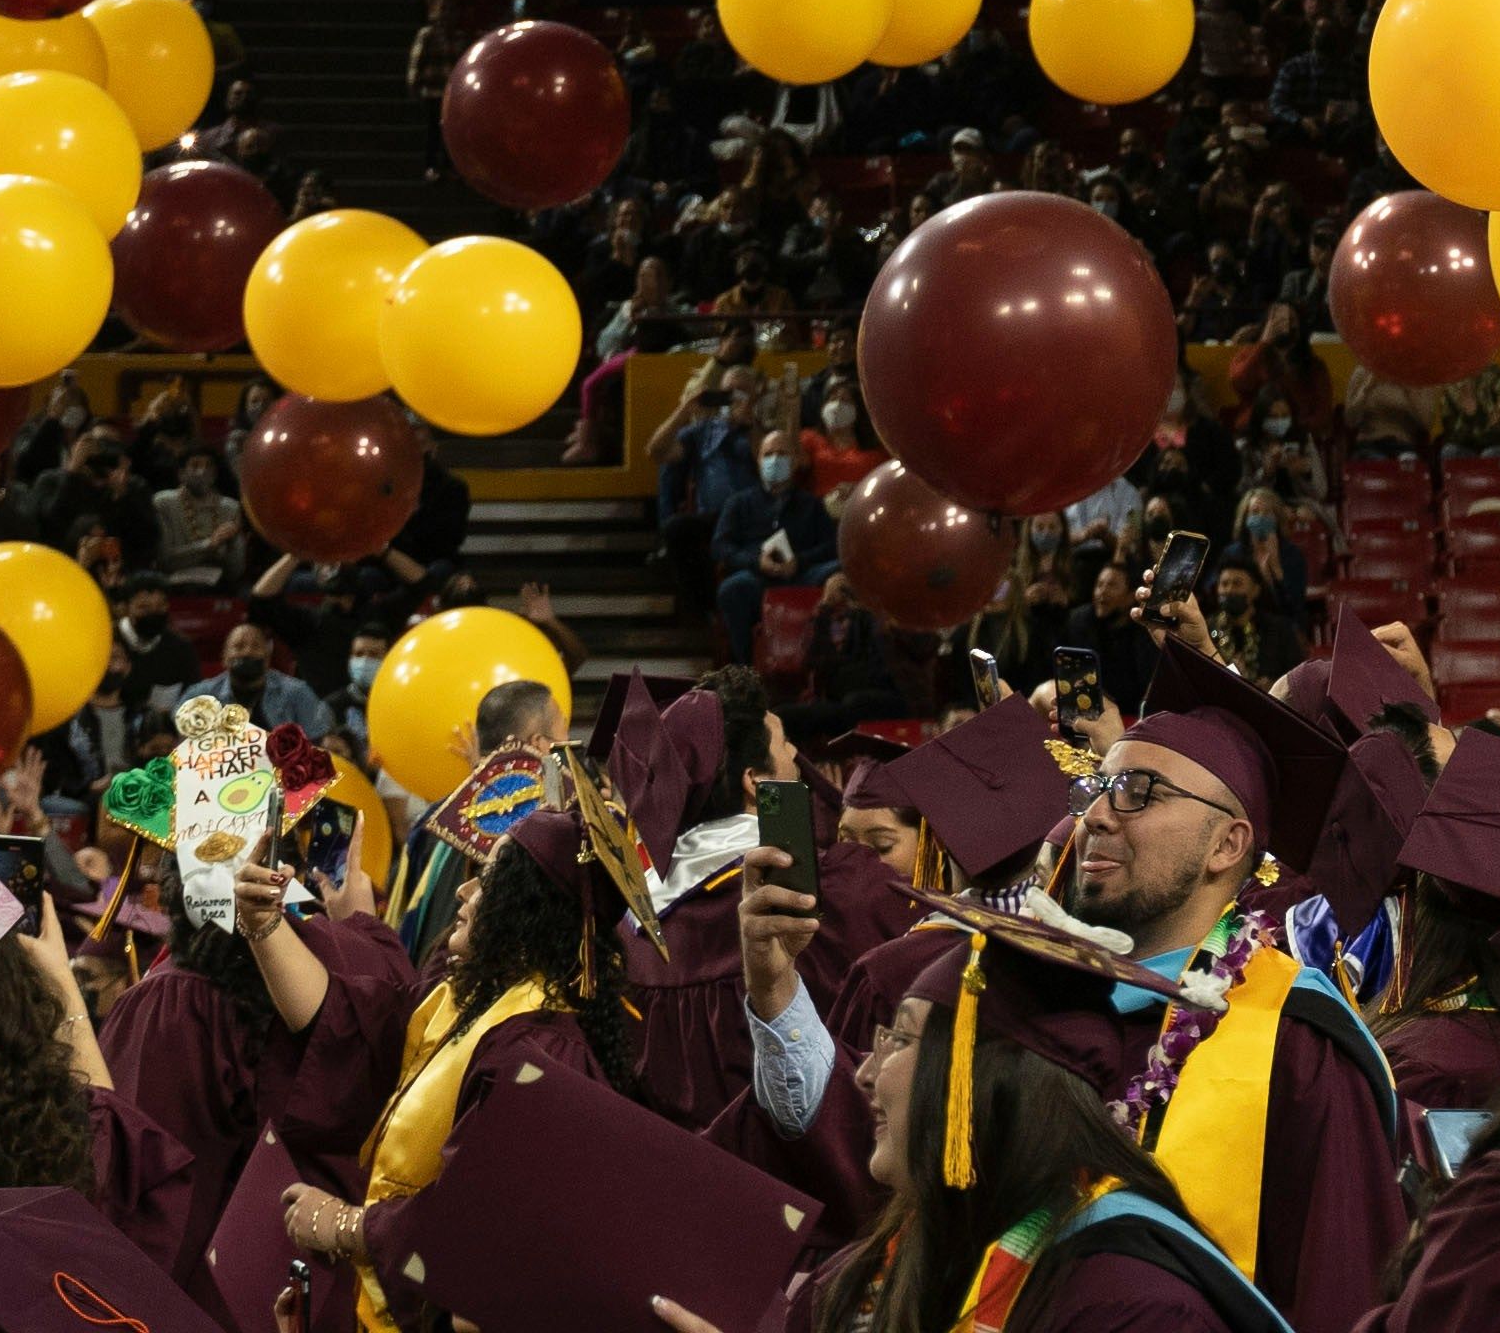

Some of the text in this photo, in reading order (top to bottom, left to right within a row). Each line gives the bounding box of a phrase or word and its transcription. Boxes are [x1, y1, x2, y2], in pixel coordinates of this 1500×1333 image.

[197, 729, 263, 751] GRIND
[178, 744, 263, 771] HARDER
[195, 758, 256, 781] THAN
[194, 789, 210, 805] A
[176, 809, 268, 842] MOLCAJET
